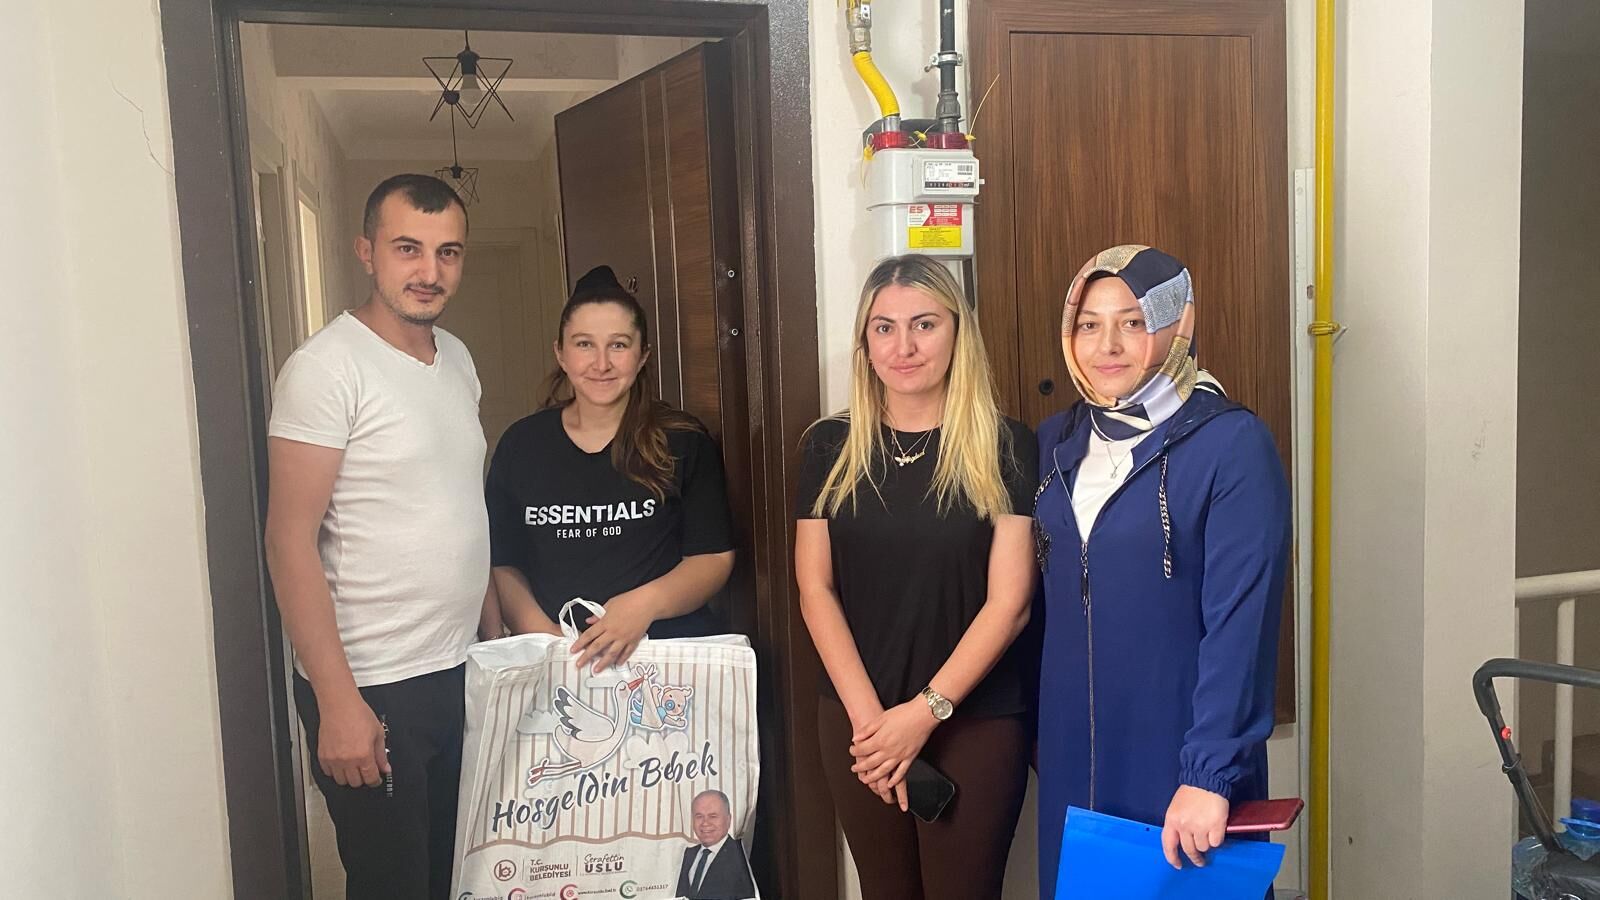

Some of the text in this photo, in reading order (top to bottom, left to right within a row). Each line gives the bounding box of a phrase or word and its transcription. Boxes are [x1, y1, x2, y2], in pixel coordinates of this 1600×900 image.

[525, 498, 656, 526] ESSENTIALS
[556, 526, 622, 538] FEAR OF GOD
[639, 741, 718, 788] Bebek
[585, 861, 623, 873] USLU
[529, 869, 571, 881] BELEDİYESİ
